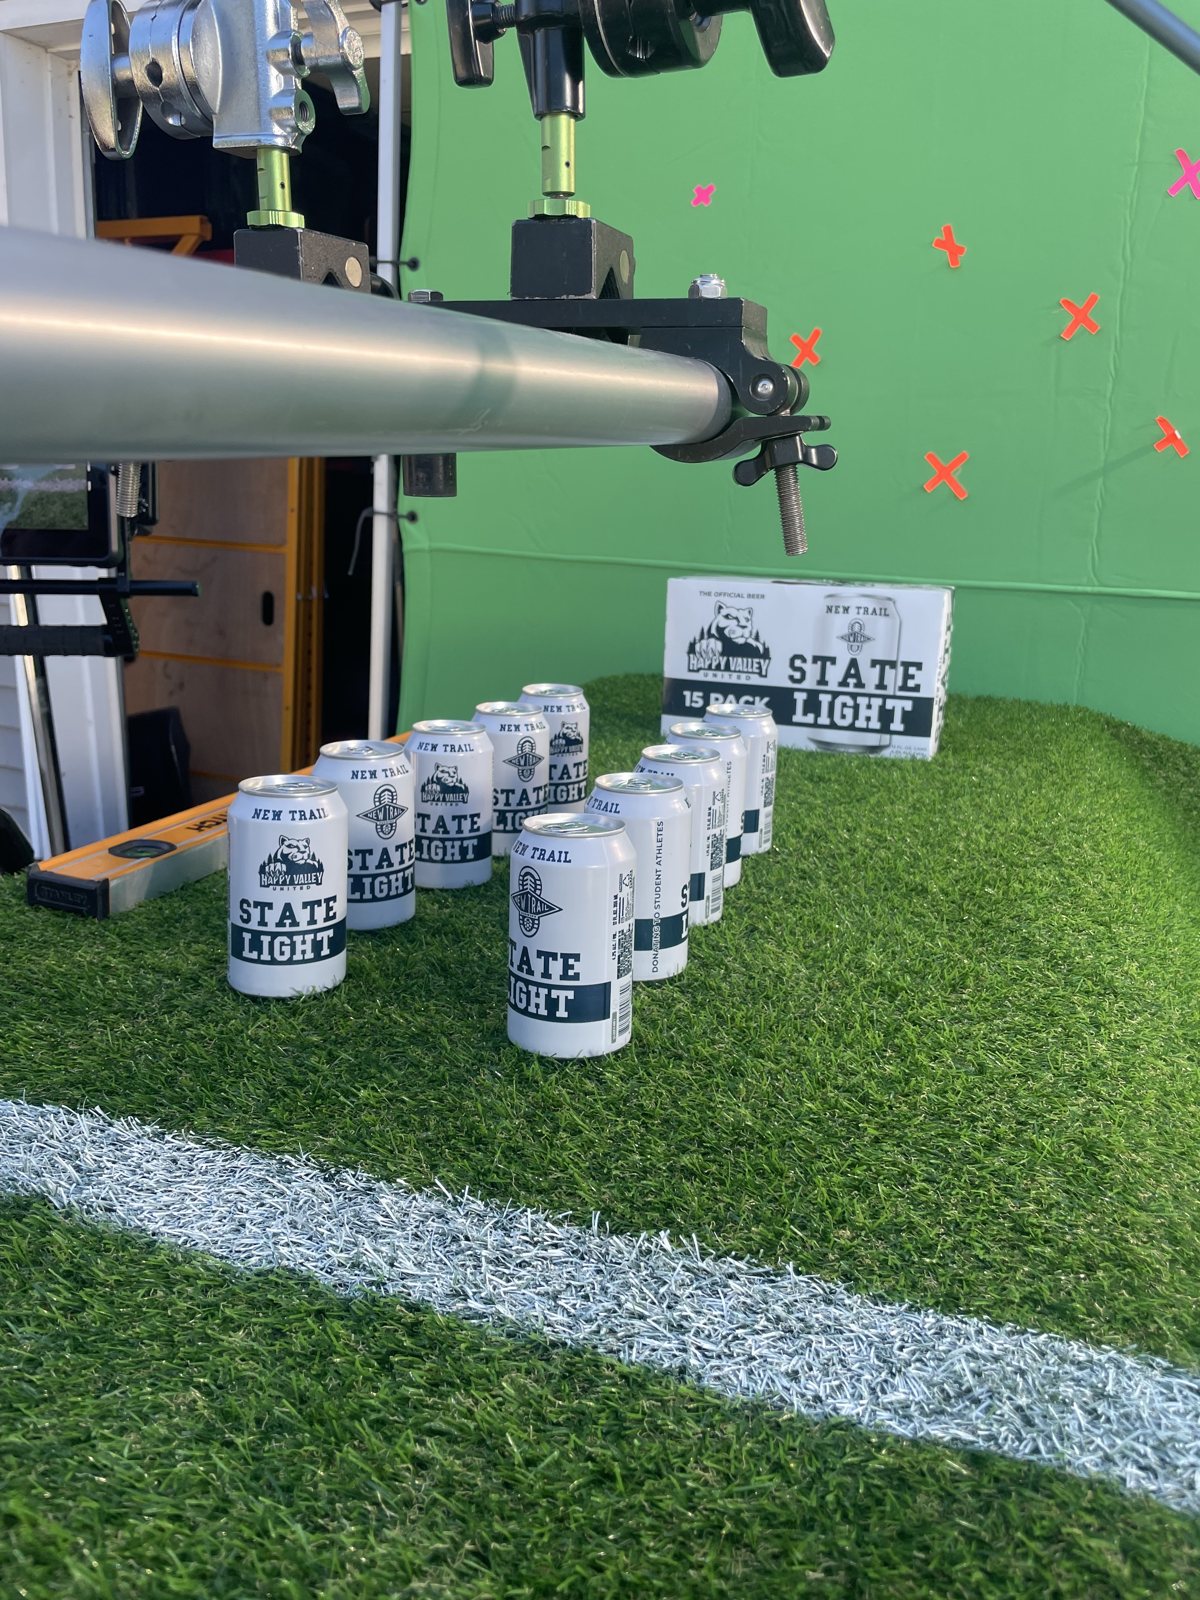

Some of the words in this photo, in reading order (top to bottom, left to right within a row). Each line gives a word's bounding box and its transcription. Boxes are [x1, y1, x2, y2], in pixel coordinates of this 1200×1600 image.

[699, 590, 712, 598] THE
[714, 591, 745, 599] OFFICIAL
[825, 605, 850, 615] NEW
[855, 606, 890, 617] TRAIL
[689, 654, 728, 671] HAPPY
[729, 657, 770, 676] VALLEY
[788, 653, 923, 693] STATE
[703, 672, 751, 681] UNITED
[543, 704, 563, 713] NEW
[683, 690, 704, 708] 15
[792, 691, 913, 732] LIGHT
[499, 723, 521, 733] NEW
[417, 741, 439, 752] NEW
[442, 743, 474, 753] TRAIL
[351, 769, 378, 780] NEW
[382, 764, 409, 778] TRAIL
[549, 760, 588, 781] TATE
[549, 781, 586, 802] IGHT
[251, 807, 283, 822] NEW
[289, 807, 329, 822] TRAIL
[367, 806, 384, 820] NEW
[592, 798, 620, 814] TRAIL
[415, 812, 481, 835] TATE
[415, 838, 478, 861] IGHT
[656, 820, 664, 866] ATHLETES
[530, 846, 572, 864] TRAIL
[261, 872, 292, 887] HAPPY
[293, 871, 323, 886] VALLEY
[654, 868, 662, 911] STUDENT
[239, 895, 338, 928] STATE
[526, 892, 549, 914] TRAIL
[653, 911, 661, 923] TO
[242, 928, 334, 962] LIGHT
[652, 925, 661, 973] DONATING
[509, 938, 581, 982] TATE
[509, 975, 575, 1018] IGHT
